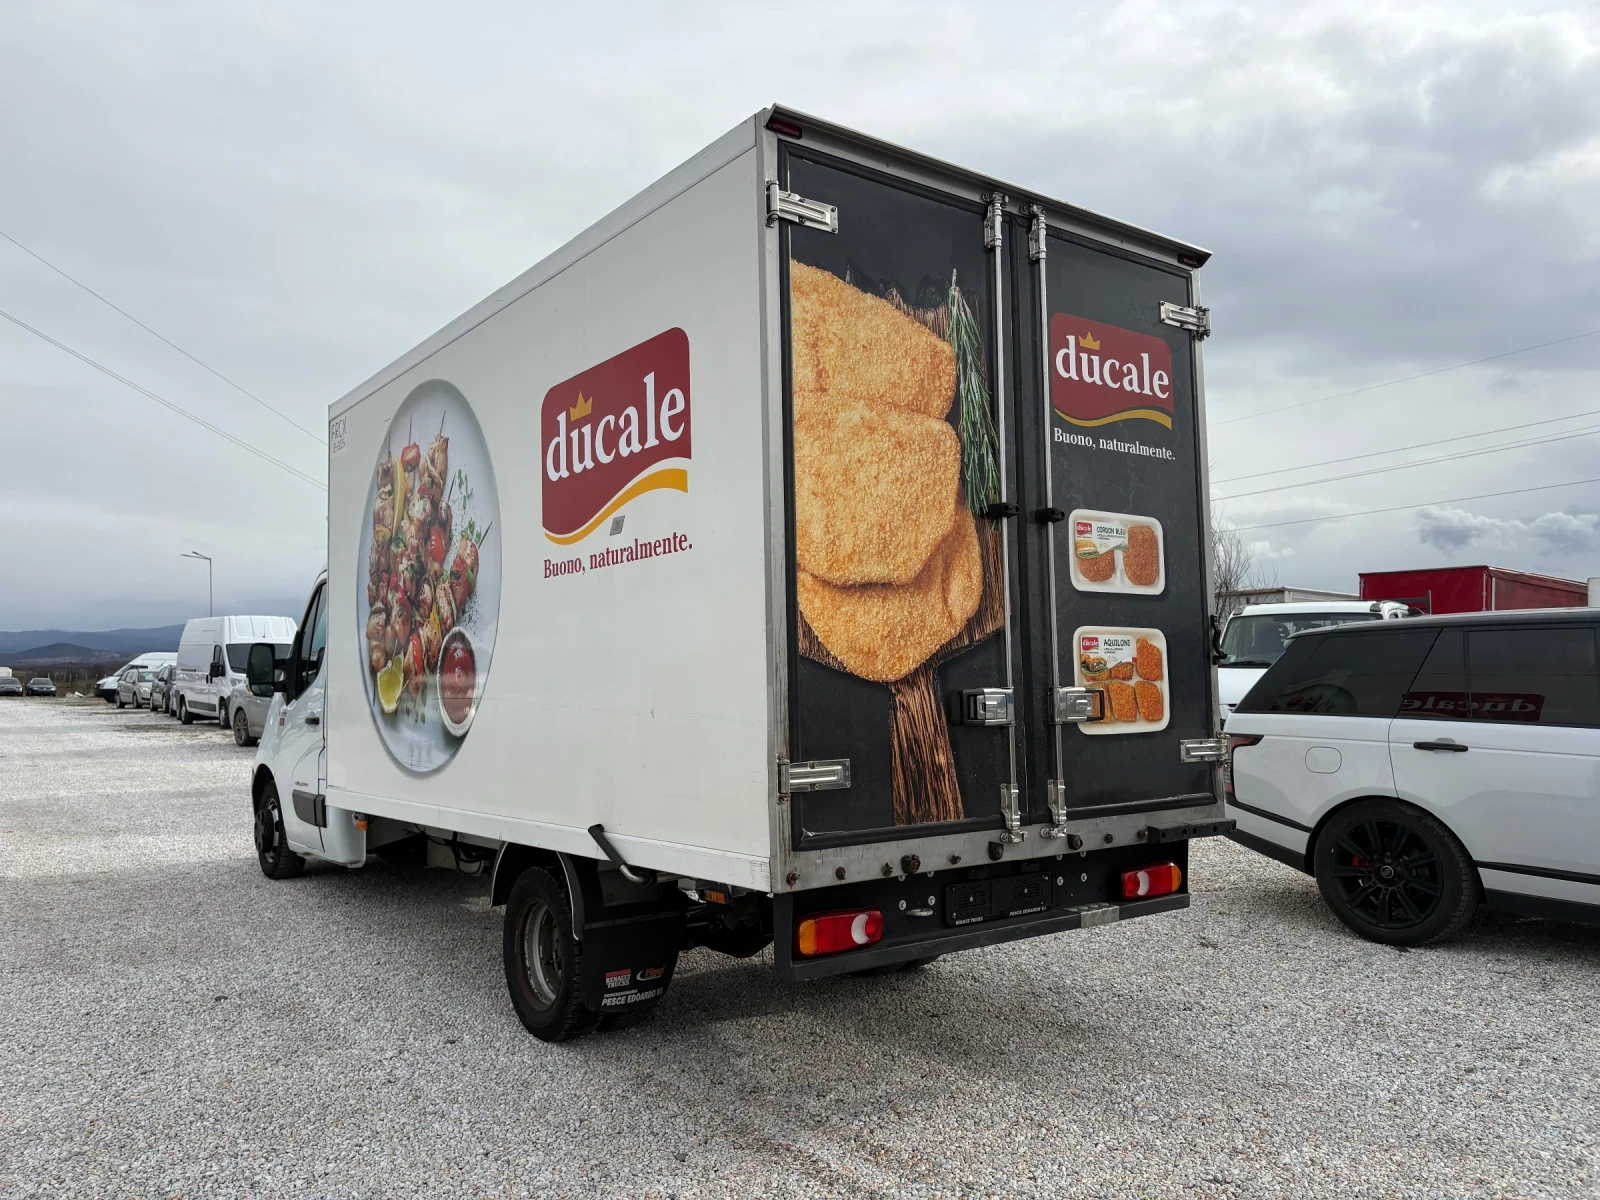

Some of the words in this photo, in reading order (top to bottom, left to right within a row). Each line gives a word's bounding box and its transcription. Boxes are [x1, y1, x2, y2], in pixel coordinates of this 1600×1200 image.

[1055, 335, 1170, 399] ducale
[546, 371, 686, 482] ducale
[1054, 427, 1096, 450] Buono,
[1099, 438, 1176, 461] naturalmente.
[1096, 526, 1115, 535] CORDON
[543, 557, 586, 579] Buono,
[590, 531, 693, 570] naturalmente.
[1103, 638, 1131, 647] AQUILONI
[605, 973, 632, 984] RENAULT
[607, 979, 630, 989] TRUCKS
[601, 996, 627, 1007] PESCE
[626, 989, 656, 1003] EDOARDO
